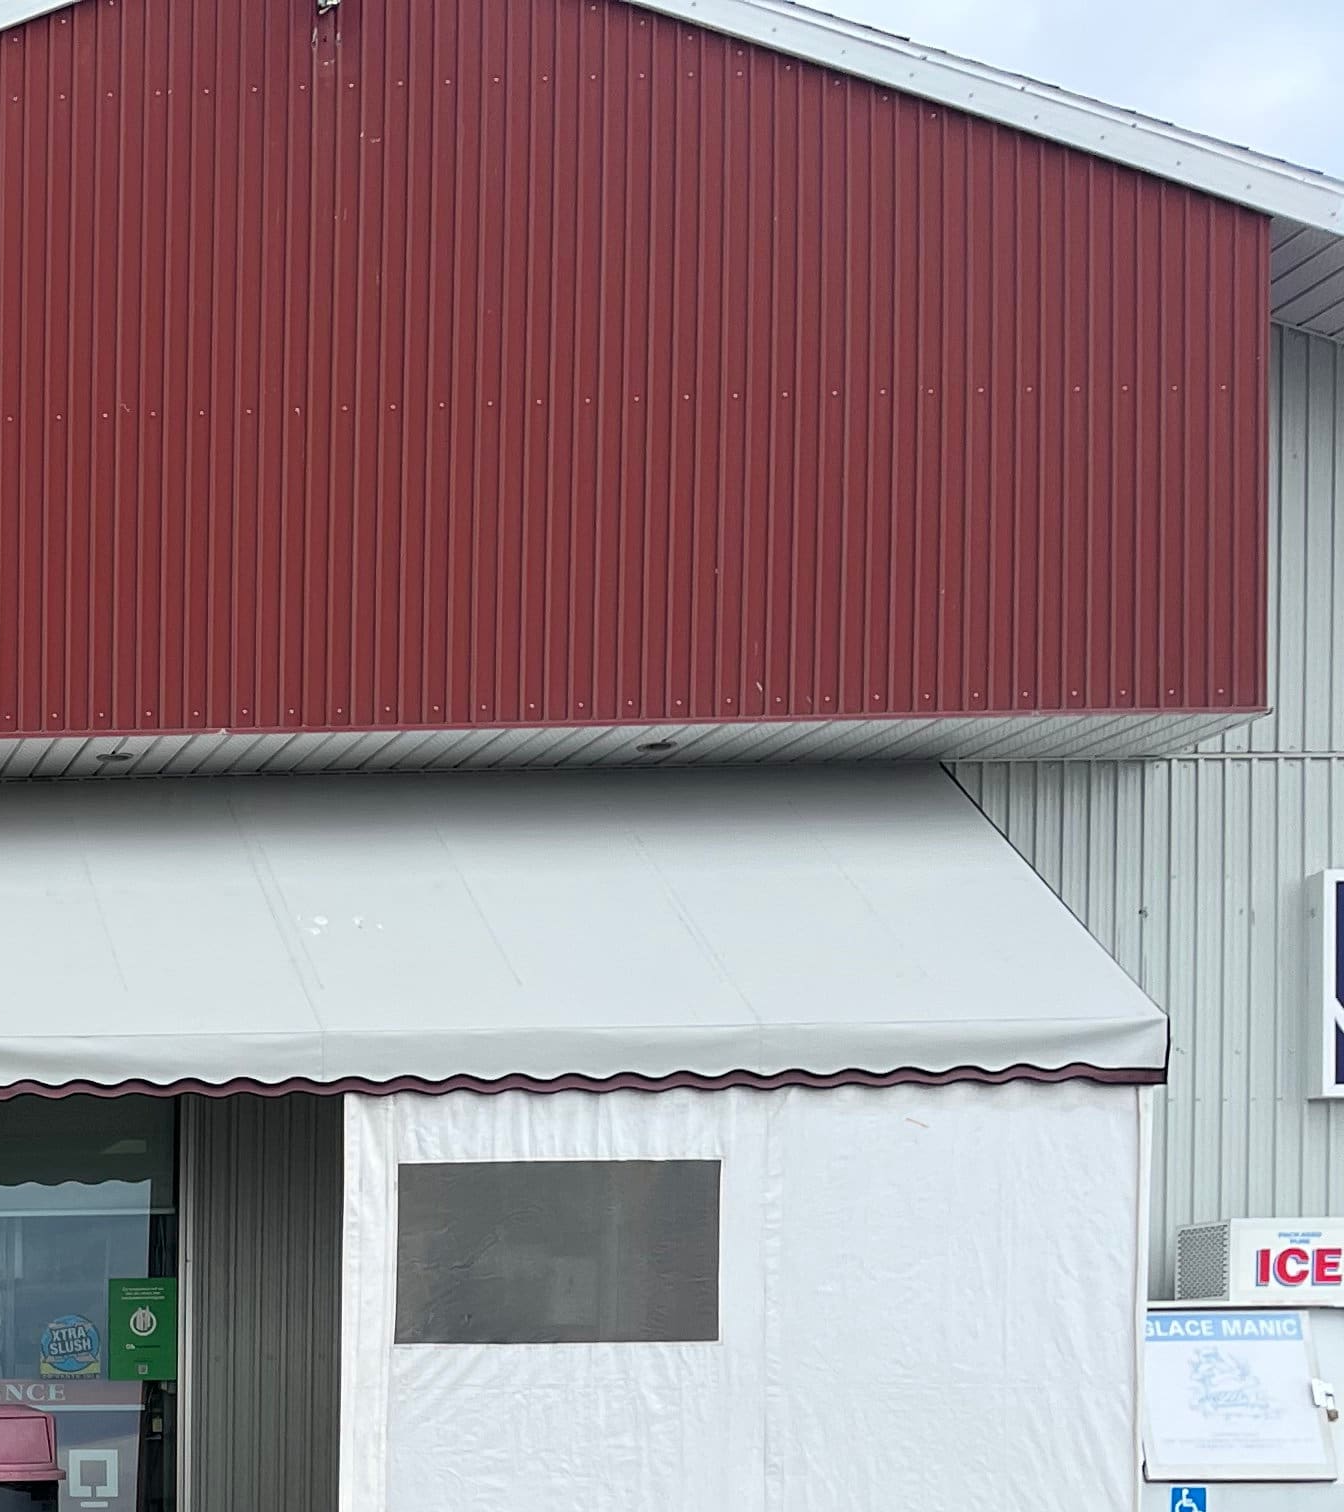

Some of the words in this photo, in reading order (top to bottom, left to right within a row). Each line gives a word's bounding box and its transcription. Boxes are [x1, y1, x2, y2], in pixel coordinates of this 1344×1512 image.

[1256, 1247, 1343, 1287] ICE
[52, 1326, 87, 1342] XTRA
[1145, 1320, 1215, 1337] GLACE
[1221, 1318, 1297, 1336] MANIC
[49, 1338, 92, 1355] SLUSH
